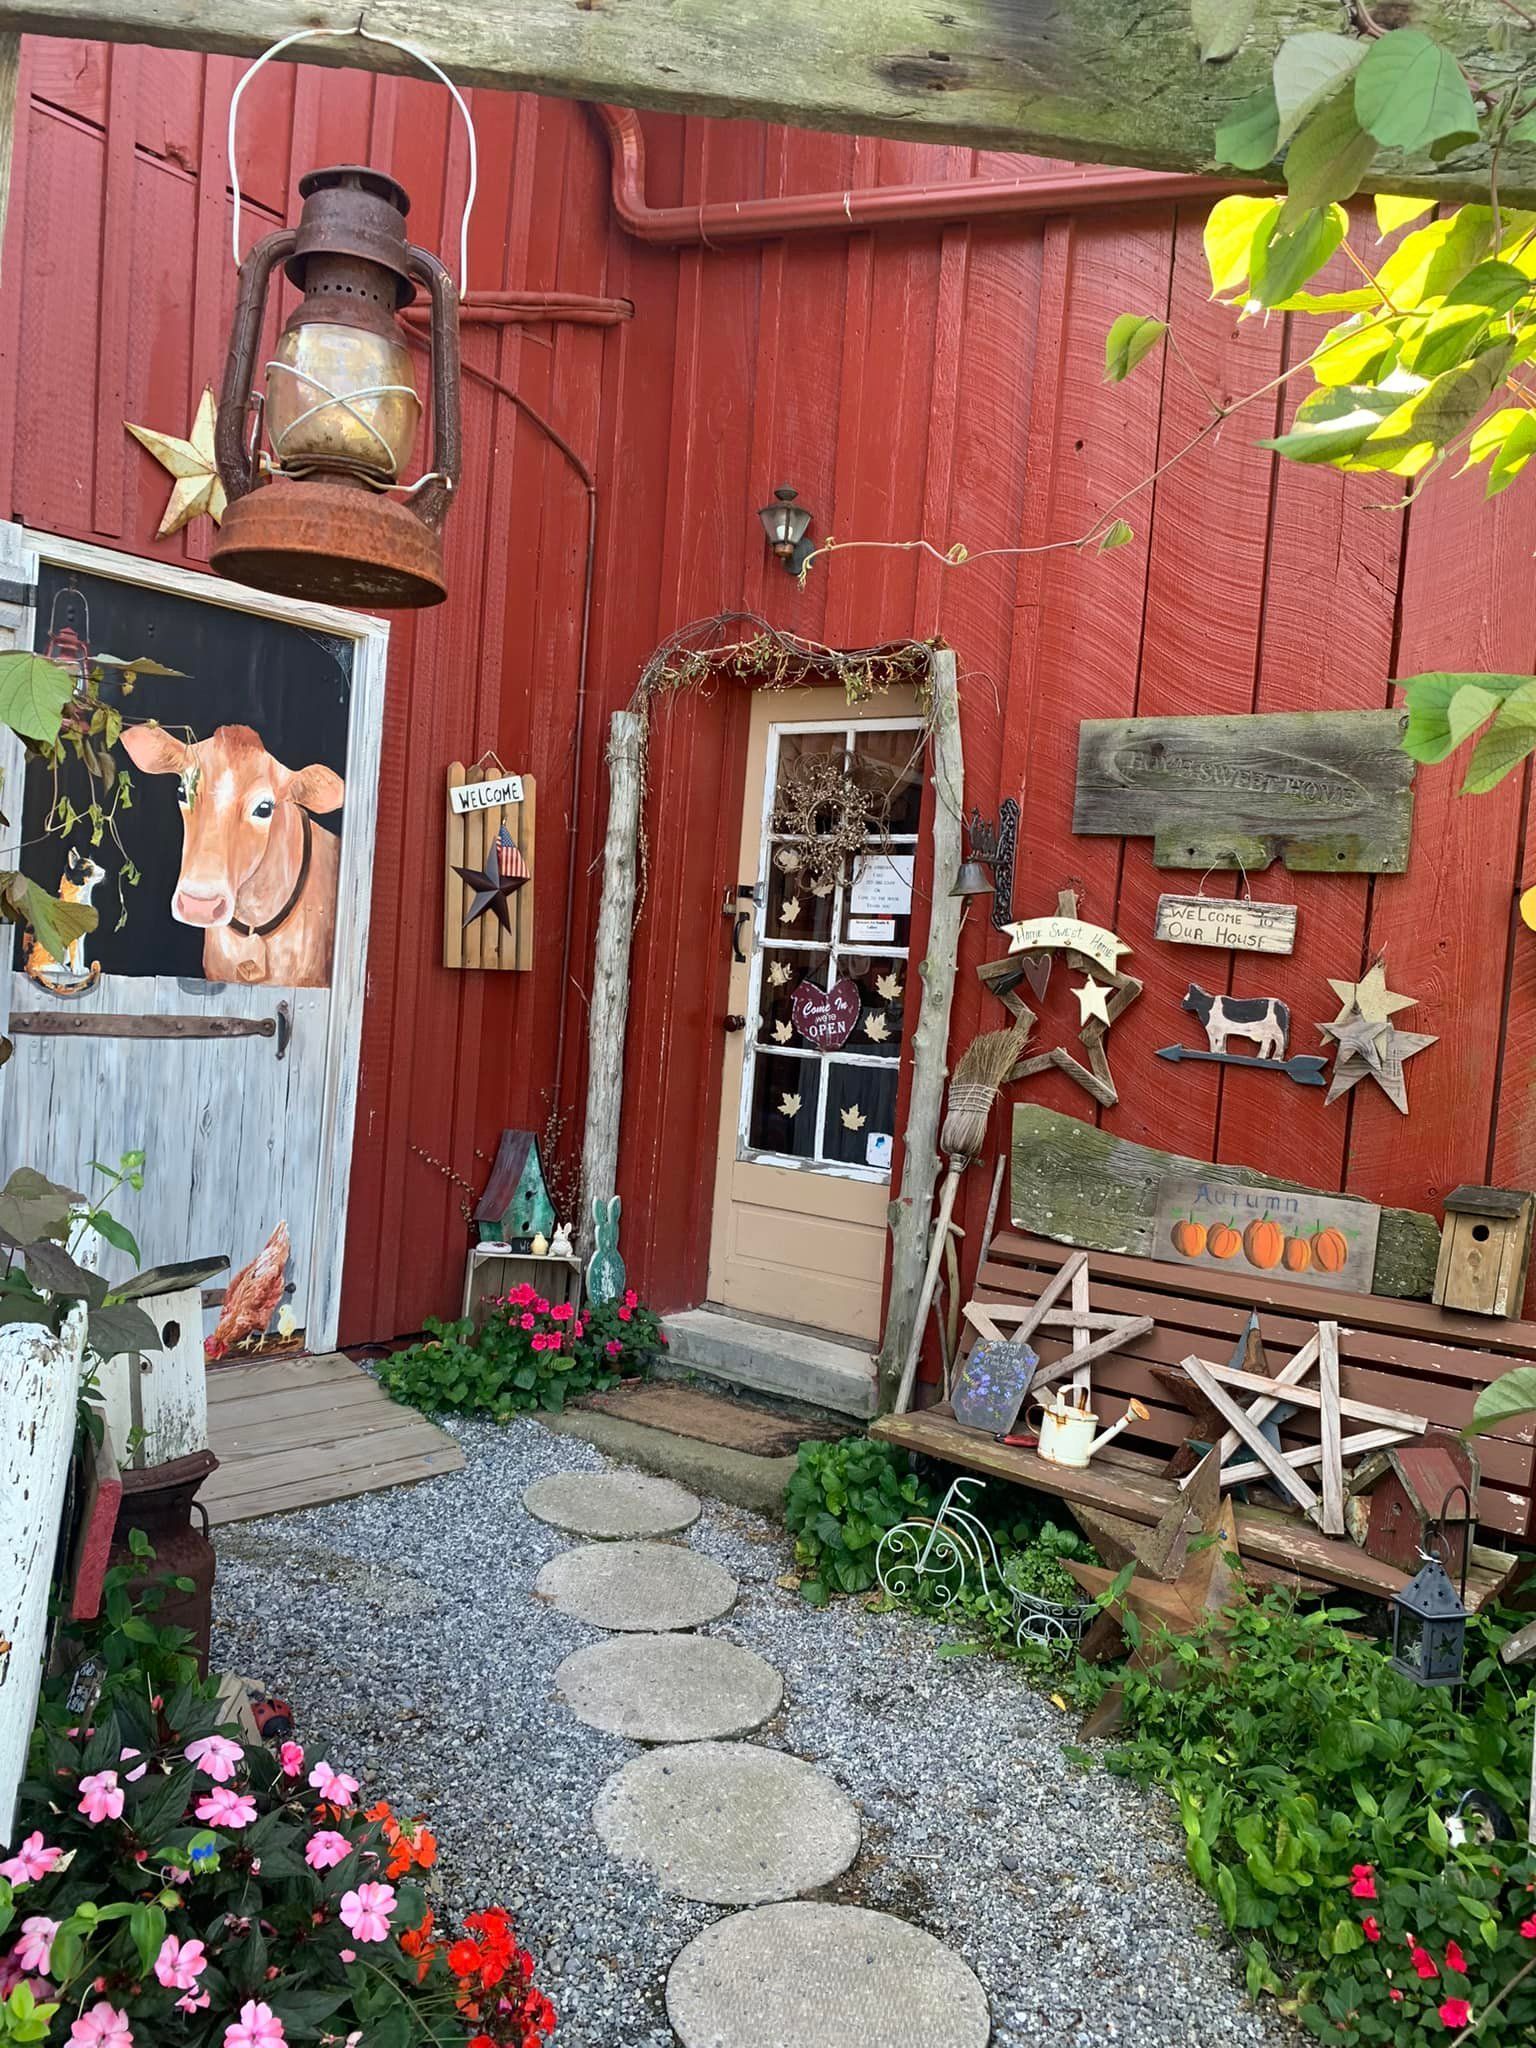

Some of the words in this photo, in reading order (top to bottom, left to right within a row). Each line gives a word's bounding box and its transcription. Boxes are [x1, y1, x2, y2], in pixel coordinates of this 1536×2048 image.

[458, 782, 520, 809] WELCOME
[1200, 762, 1278, 794] SWEET
[1285, 778, 1357, 808] HOME
[1171, 905, 1243, 924] WELCOME
[802, 1000, 831, 1017] Come
[834, 997, 849, 1011] In
[808, 1020, 847, 1038] OPEN
[1194, 1182, 1299, 1213] Autumn
